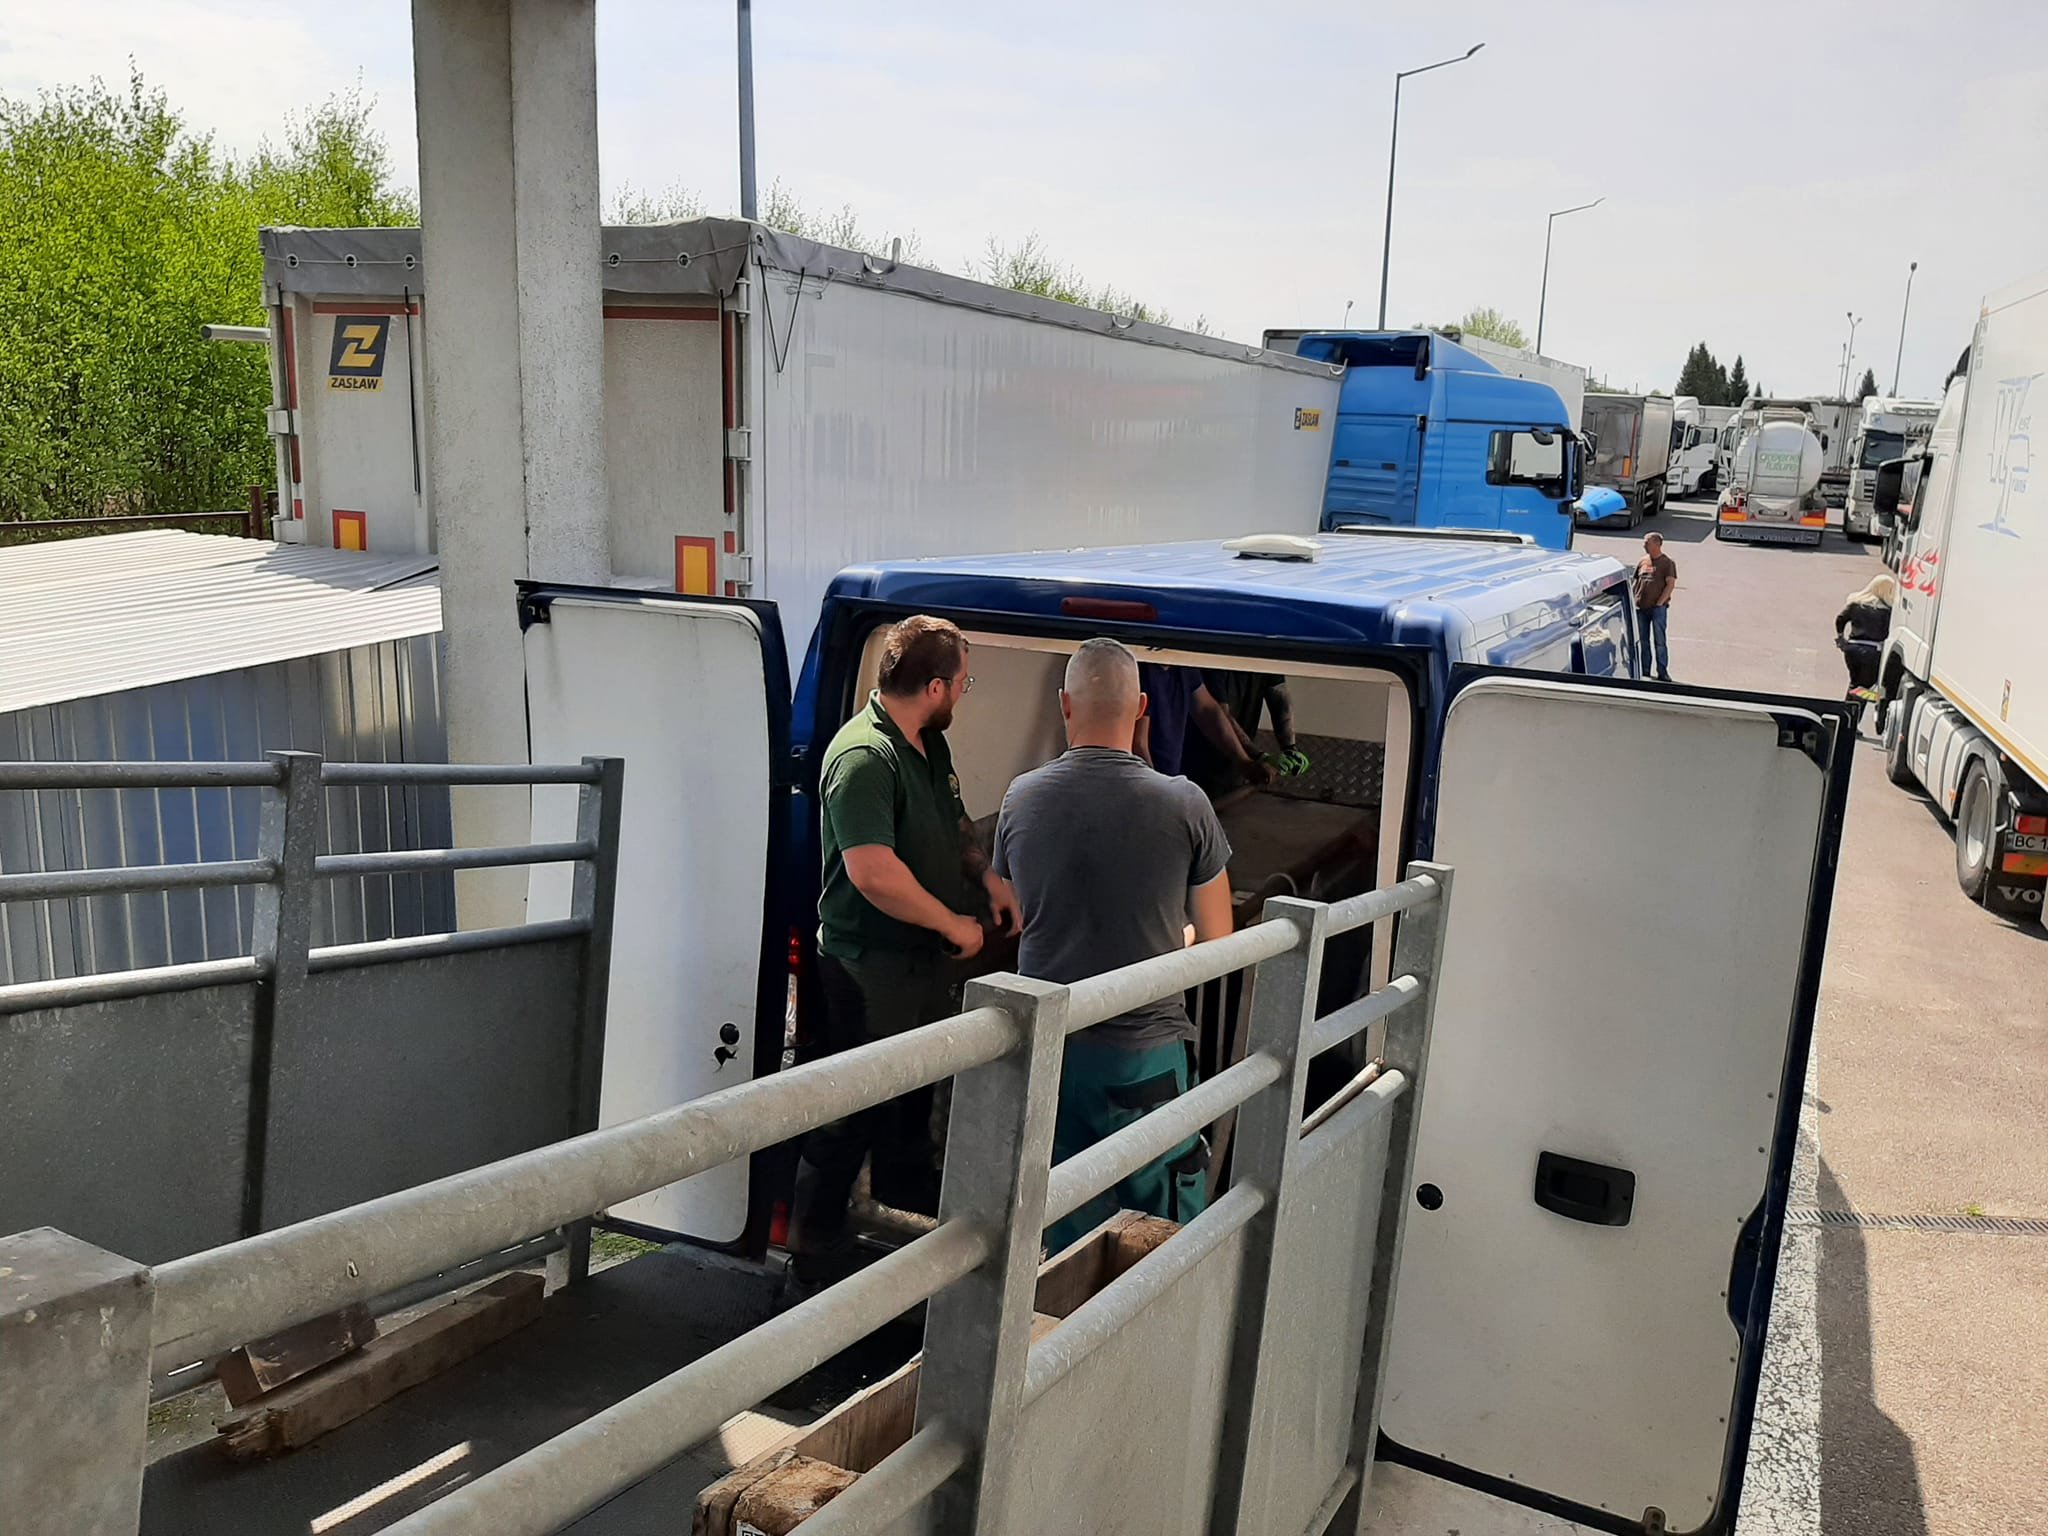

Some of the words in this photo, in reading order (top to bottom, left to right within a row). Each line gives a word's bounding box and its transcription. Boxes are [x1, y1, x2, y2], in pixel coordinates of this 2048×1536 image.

[331, 377, 379, 390] ZASŁAW
[2014, 835, 2036, 849] BC
[1997, 886, 2043, 904] VO
